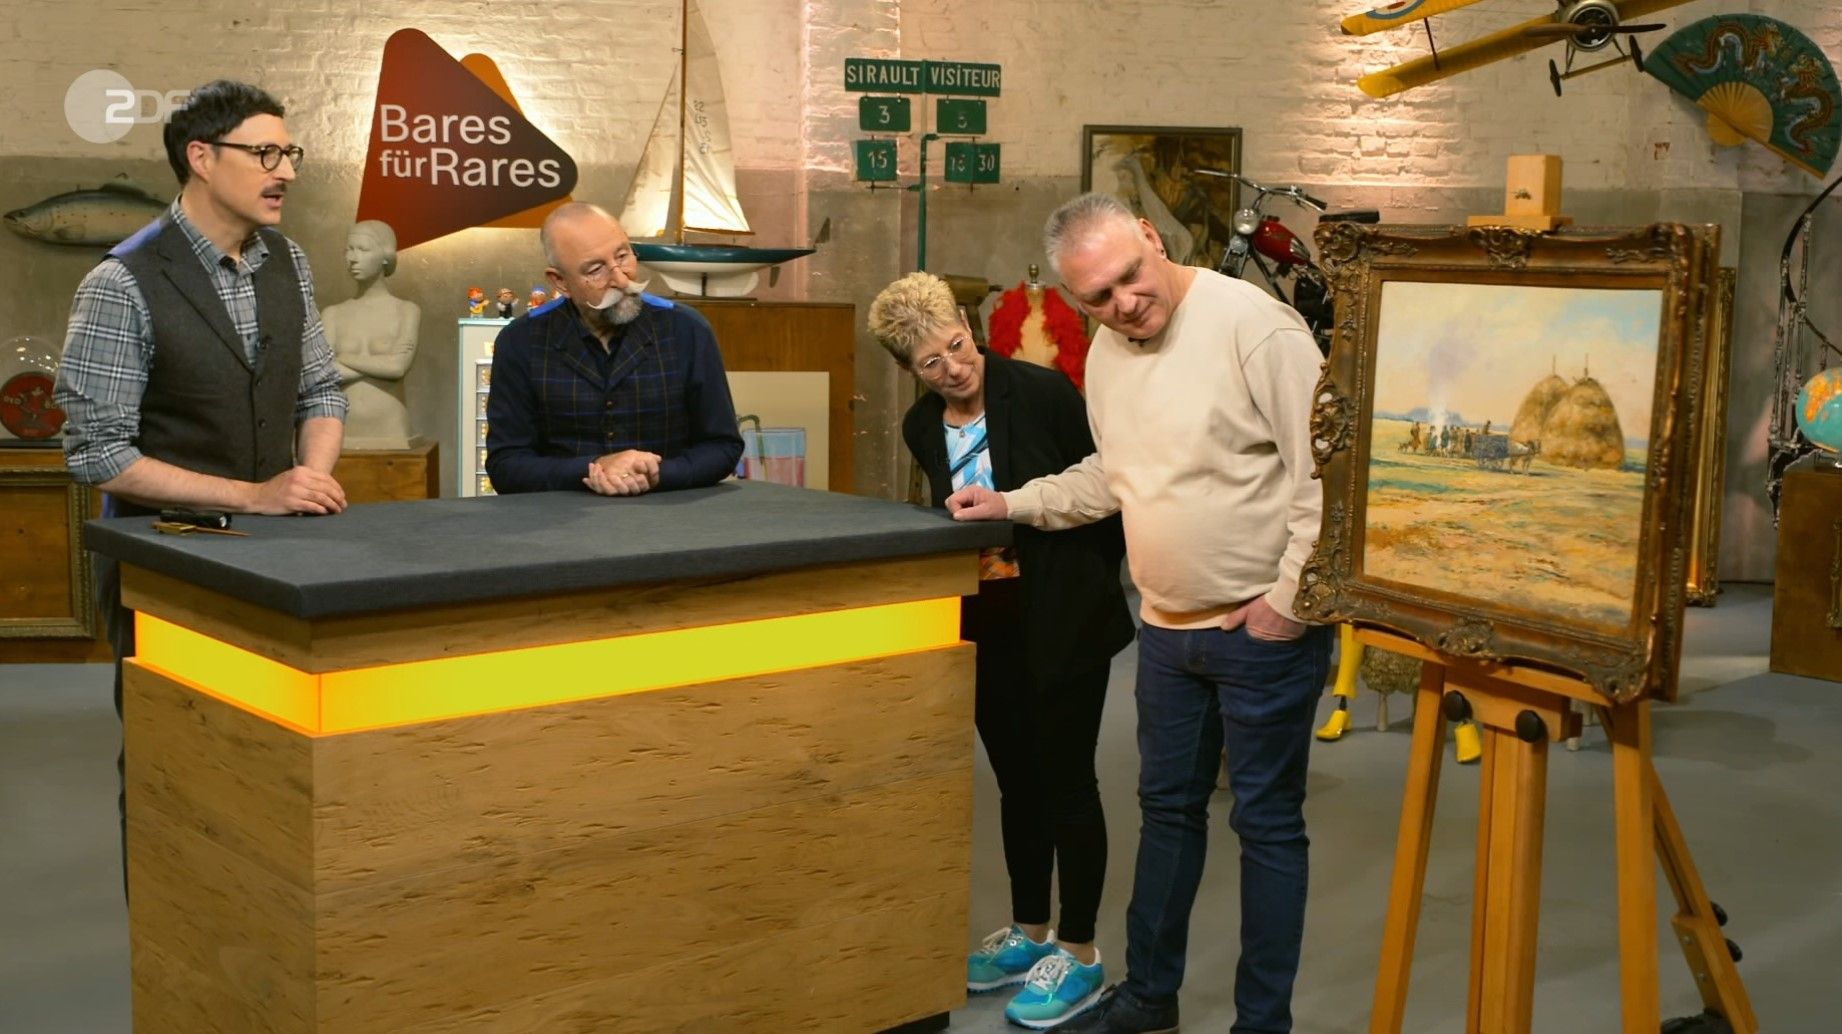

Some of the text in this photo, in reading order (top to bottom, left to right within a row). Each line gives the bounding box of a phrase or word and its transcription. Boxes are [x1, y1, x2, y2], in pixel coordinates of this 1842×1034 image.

[847, 64, 920, 86] SIRAULT
[380, 103, 512, 145] Bares
[878, 105, 891, 124] 3
[379, 147, 561, 188] für Rares
[867, 150, 888, 169] 15
[977, 153, 996, 172] 30
